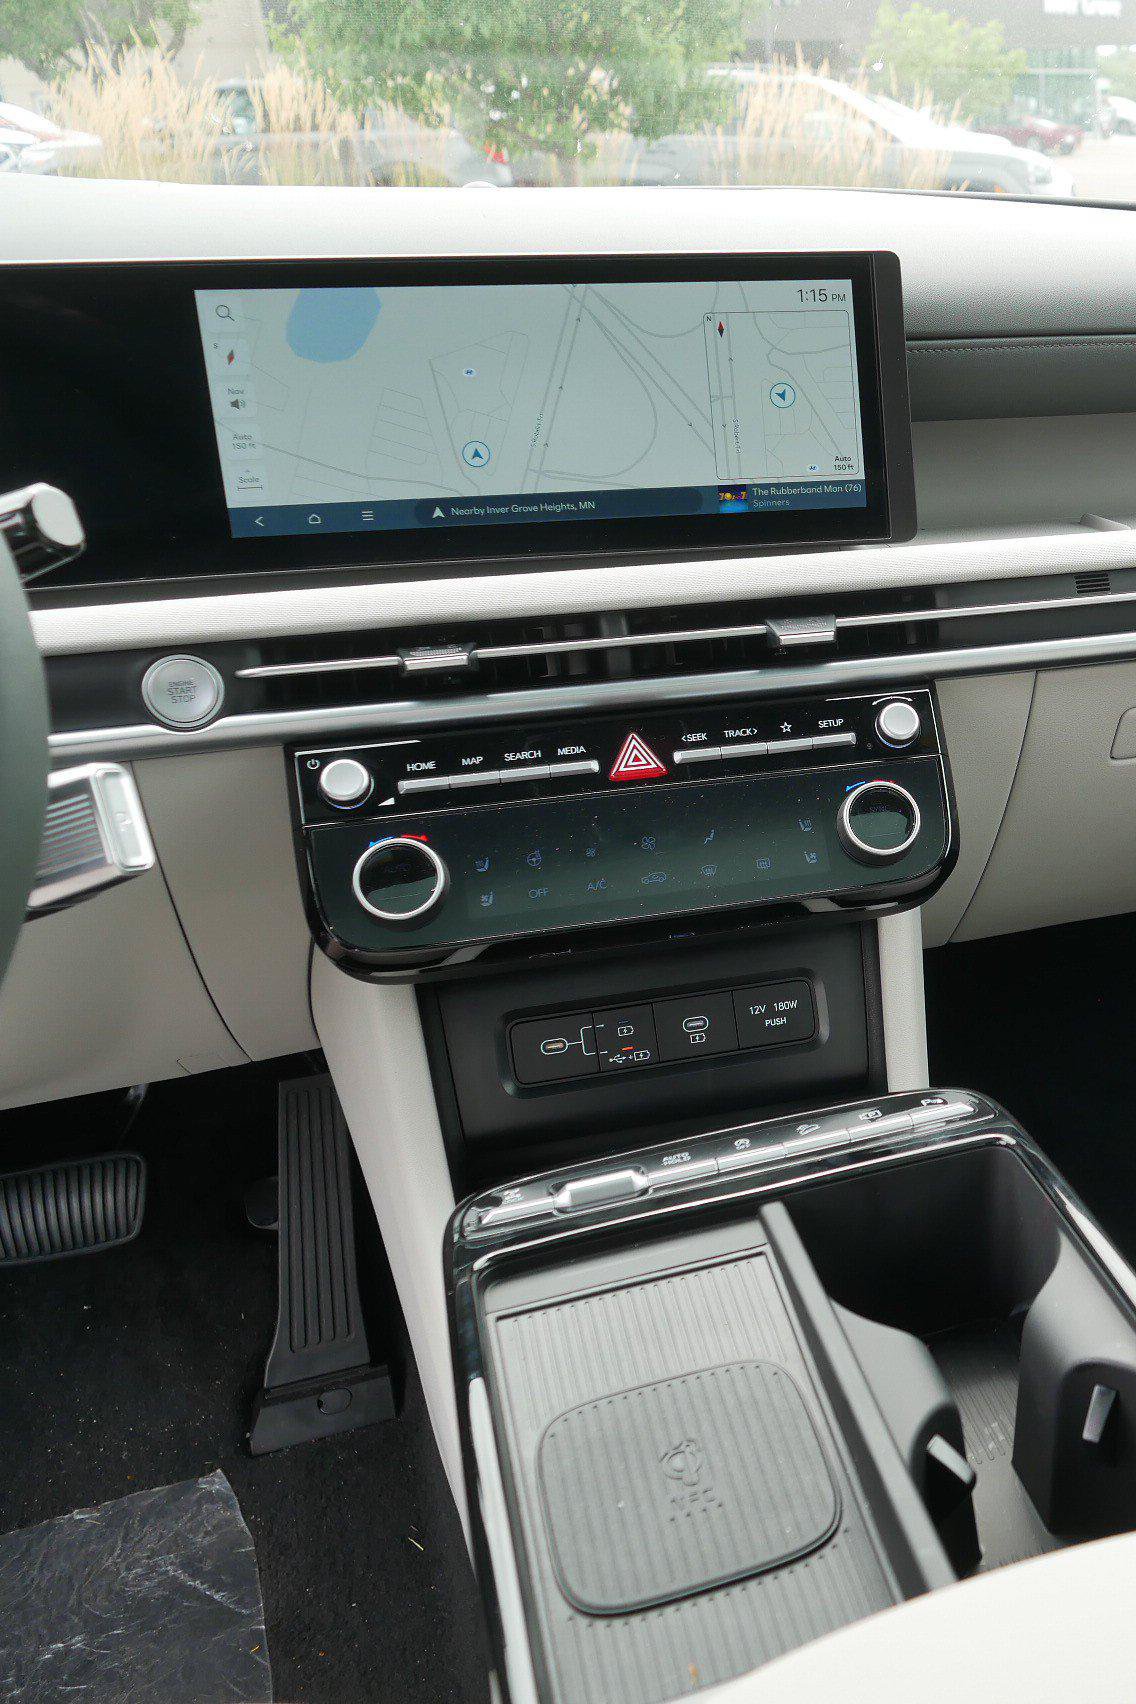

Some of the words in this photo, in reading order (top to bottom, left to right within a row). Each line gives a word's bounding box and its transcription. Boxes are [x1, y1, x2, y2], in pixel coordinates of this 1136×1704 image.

[797, 288, 828, 302] 1:15
[832, 293, 846, 302] PM
[238, 476, 260, 484] Scale
[752, 487, 769, 496] The
[770, 486, 824, 495] Rubberband
[826, 484, 843, 492] Man
[845, 483, 862, 492] (76)
[452, 506, 485, 516] Nearby
[486, 505, 509, 514] Inver
[512, 504, 538, 513] Grove
[540, 502, 577, 512] Heights,
[579, 500, 596, 510] MN
[754, 499, 790, 508] Spinners
[168, 686, 196, 696] START
[171, 695, 196, 704] STOP
[818, 718, 844, 729] SETUP
[406, 760, 436, 772] HOME
[462, 756, 483, 766] MAP
[504, 750, 542, 762] SEARCH
[557, 746, 586, 756] MEDIA
[586, 879, 608, 892] A/C
[528, 888, 549, 899] OFF
[749, 1004, 766, 1015] 12V
[773, 1000, 798, 1012] 180W
[764, 1016, 788, 1027] PUSH
